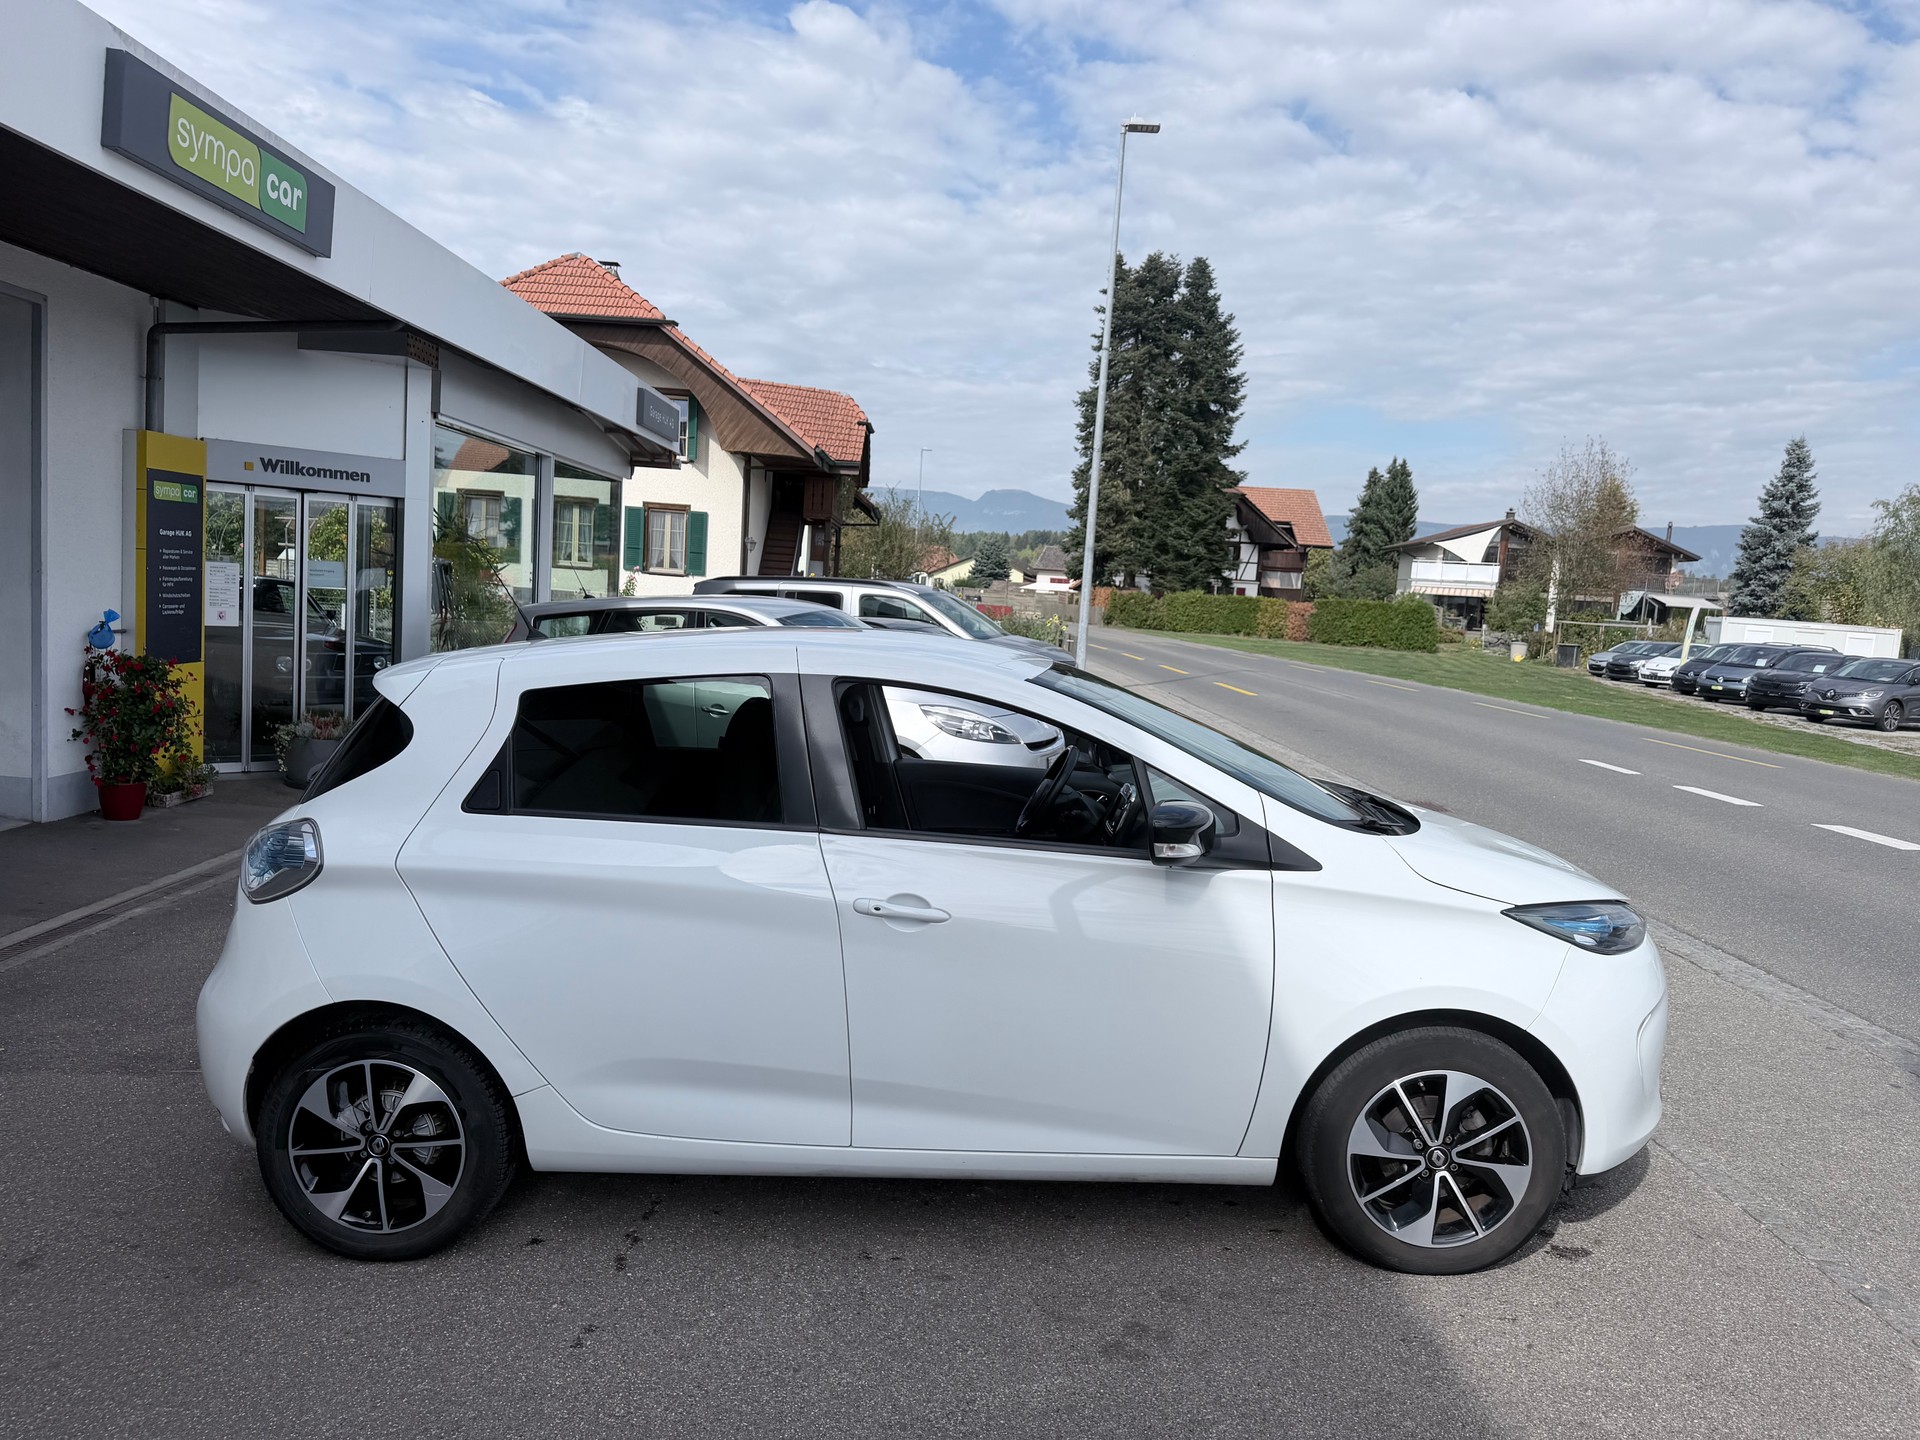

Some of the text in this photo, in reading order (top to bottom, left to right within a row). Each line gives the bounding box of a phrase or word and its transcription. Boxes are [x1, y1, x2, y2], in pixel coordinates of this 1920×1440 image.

[177, 117, 303, 211] sympa car
[259, 457, 371, 483] Willkommen
[155, 486, 197, 499] sympa car
[159, 528, 175, 537] Garage
